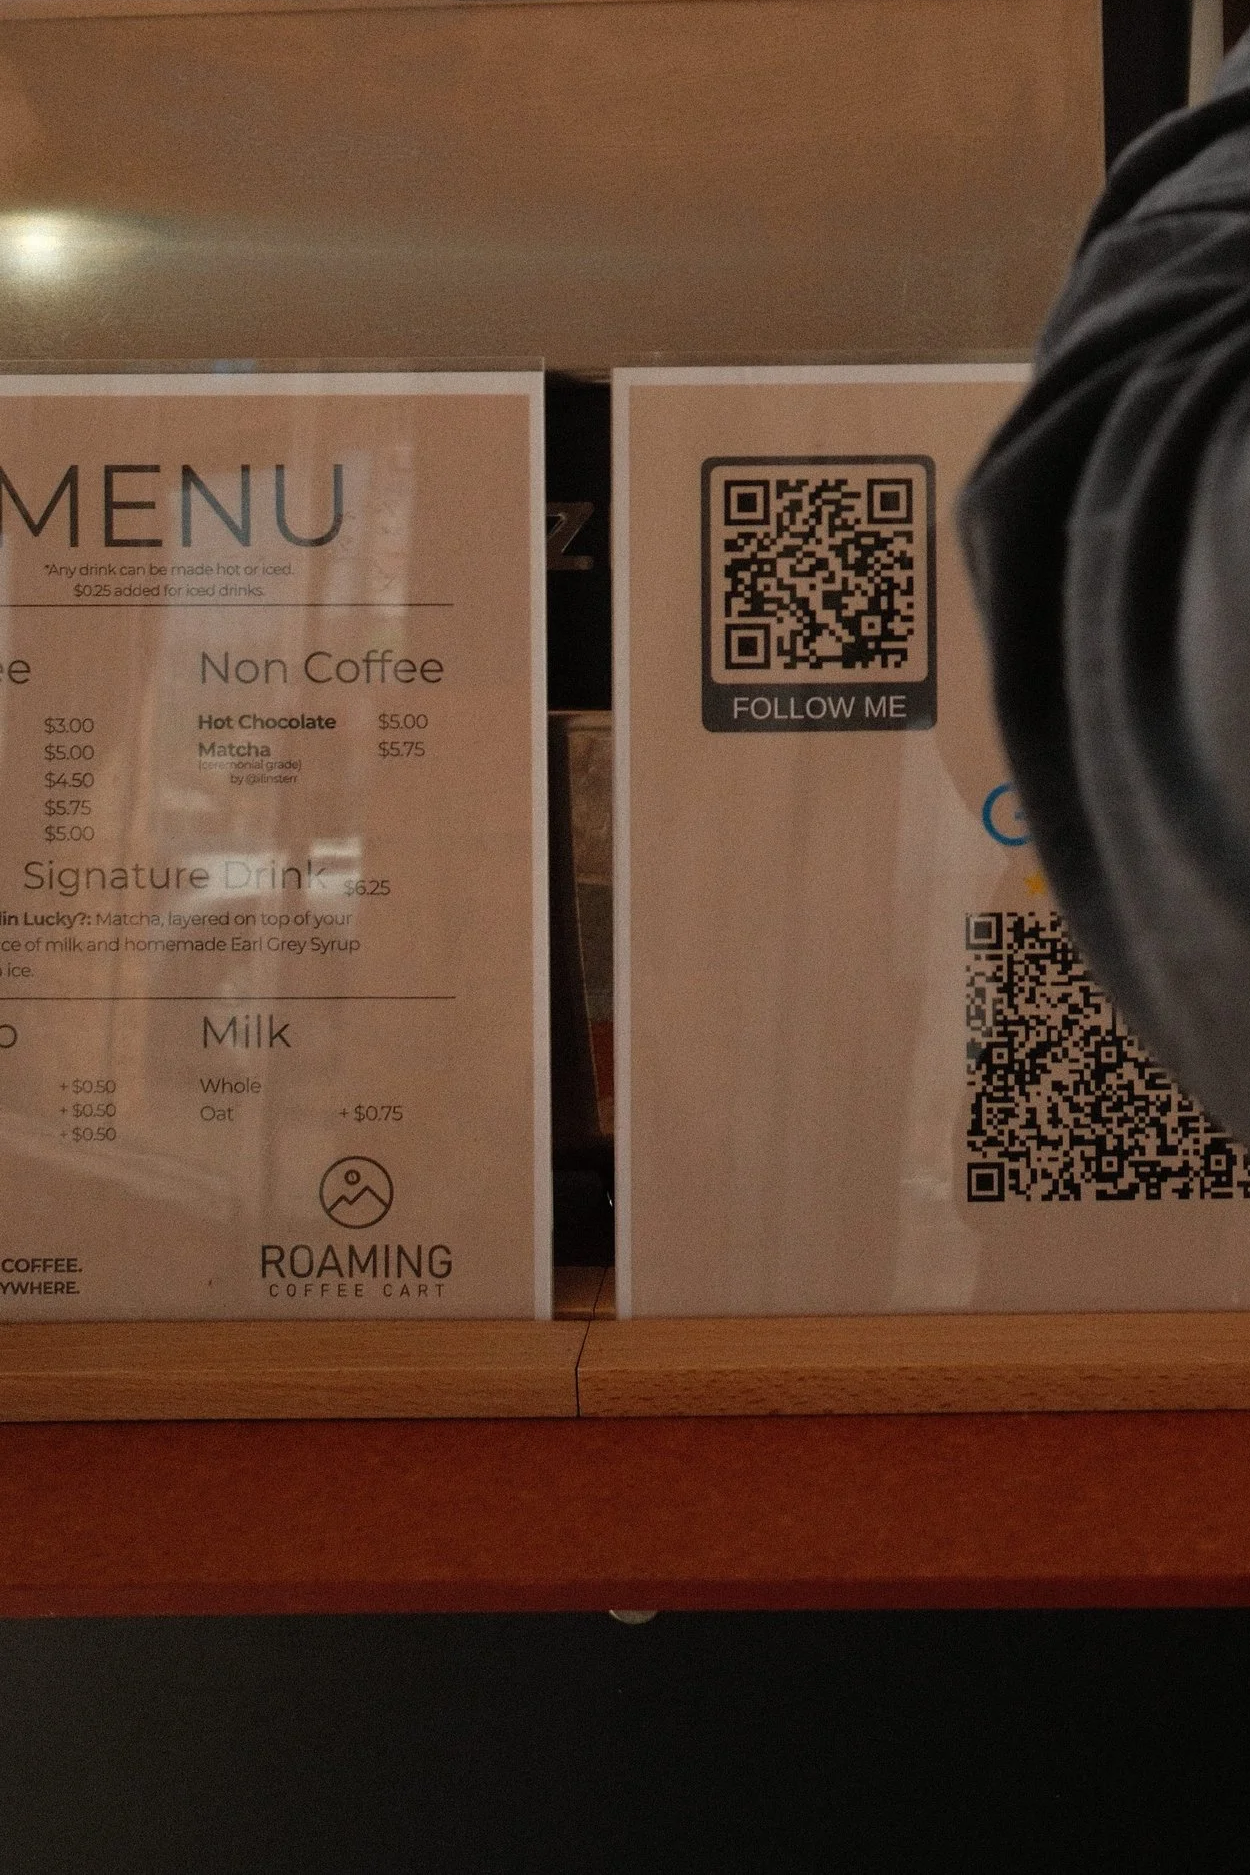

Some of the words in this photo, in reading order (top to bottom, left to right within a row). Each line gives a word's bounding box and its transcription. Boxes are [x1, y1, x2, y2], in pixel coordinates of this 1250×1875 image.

[0, 463, 344, 549] MENU
[79, 563, 117, 576] drink
[120, 566, 147, 576] can
[149, 563, 168, 576] be
[171, 563, 214, 576] made
[216, 563, 241, 576] hot
[243, 566, 259, 576] or
[74, 583, 112, 598] $0.25
[114, 584, 161, 597] added
[163, 583, 183, 597] for
[185, 584, 217, 597] iced
[200, 651, 288, 684] Non
[303, 649, 445, 684] Coffee
[731, 696, 856, 720] FOLLOW
[864, 695, 907, 719] ME
[44, 716, 95, 734] $3.00
[198, 714, 234, 730] Hot
[238, 713, 337, 730] Chocolate
[378, 712, 429, 731] $5.00
[44, 744, 95, 762] $5.00
[199, 741, 271, 757] Matcha
[378, 740, 426, 759] $5.75
[266, 759, 302, 773] grade)
[44, 771, 95, 789] $4.50
[230, 773, 245, 785] by
[44, 798, 92, 817] $5.75
[44, 825, 95, 843] $5.00
[23, 860, 210, 896] Signature
[344, 879, 391, 897] $6.25
[23, 910, 92, 930] Lucky?:
[96, 911, 165, 929] Matcha,
[168, 911, 231, 930] layered
[233, 915, 257, 926] on
[260, 914, 291, 930] top
[293, 911, 312, 926] of
[312, 915, 353, 930] your
[24, 937, 43, 952] of
[46, 936, 83, 952] milk
[86, 937, 121, 952] and
[124, 937, 227, 952] homemade
[231, 936, 262, 952] Earl
[267, 937, 307, 955] Grey
[310, 937, 361, 956] Syrup
[7, 962, 35, 977] ice.
[202, 1014, 292, 1049] Milk
[72, 1078, 116, 1095] $0.50
[199, 1077, 262, 1094] Whole
[72, 1102, 116, 1119] $0.50
[200, 1105, 234, 1122] Oat
[353, 1103, 403, 1123] $0.75
[72, 1125, 116, 1143] $0.50
[1, 1257, 84, 1273] COFFEE.
[260, 1243, 453, 1280] ROAMING
[268, 1282, 365, 1298] COFFEE
[382, 1281, 446, 1297] CART
